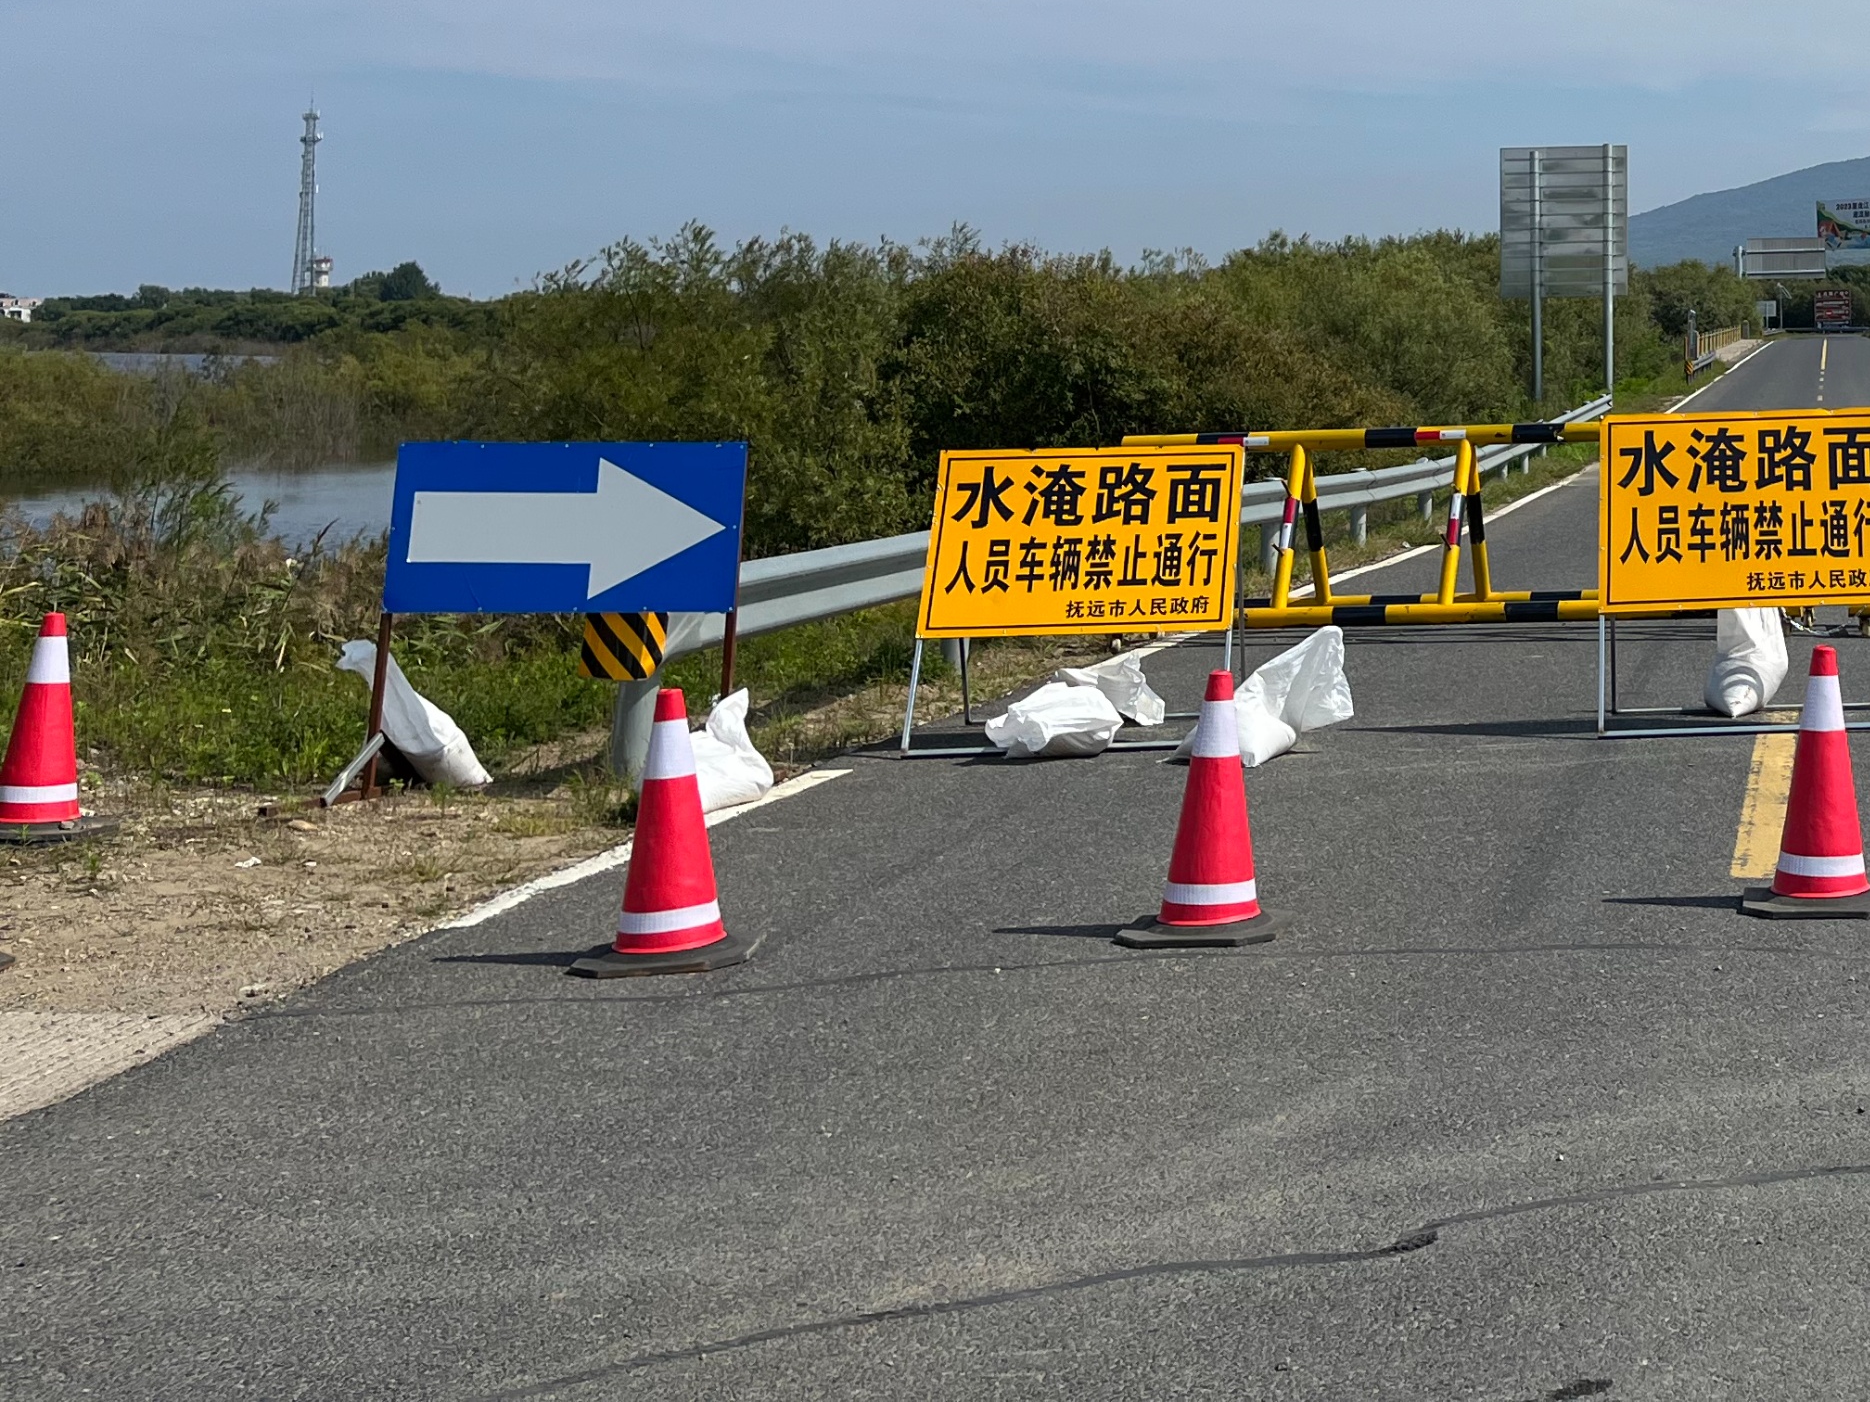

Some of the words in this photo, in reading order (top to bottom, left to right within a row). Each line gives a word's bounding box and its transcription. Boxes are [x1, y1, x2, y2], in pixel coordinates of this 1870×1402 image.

[951, 462, 1228, 529] 水淹路面
[944, 531, 1219, 595] 人员车辆禁止通行
[1065, 595, 1211, 619] 抚远市人民政府
